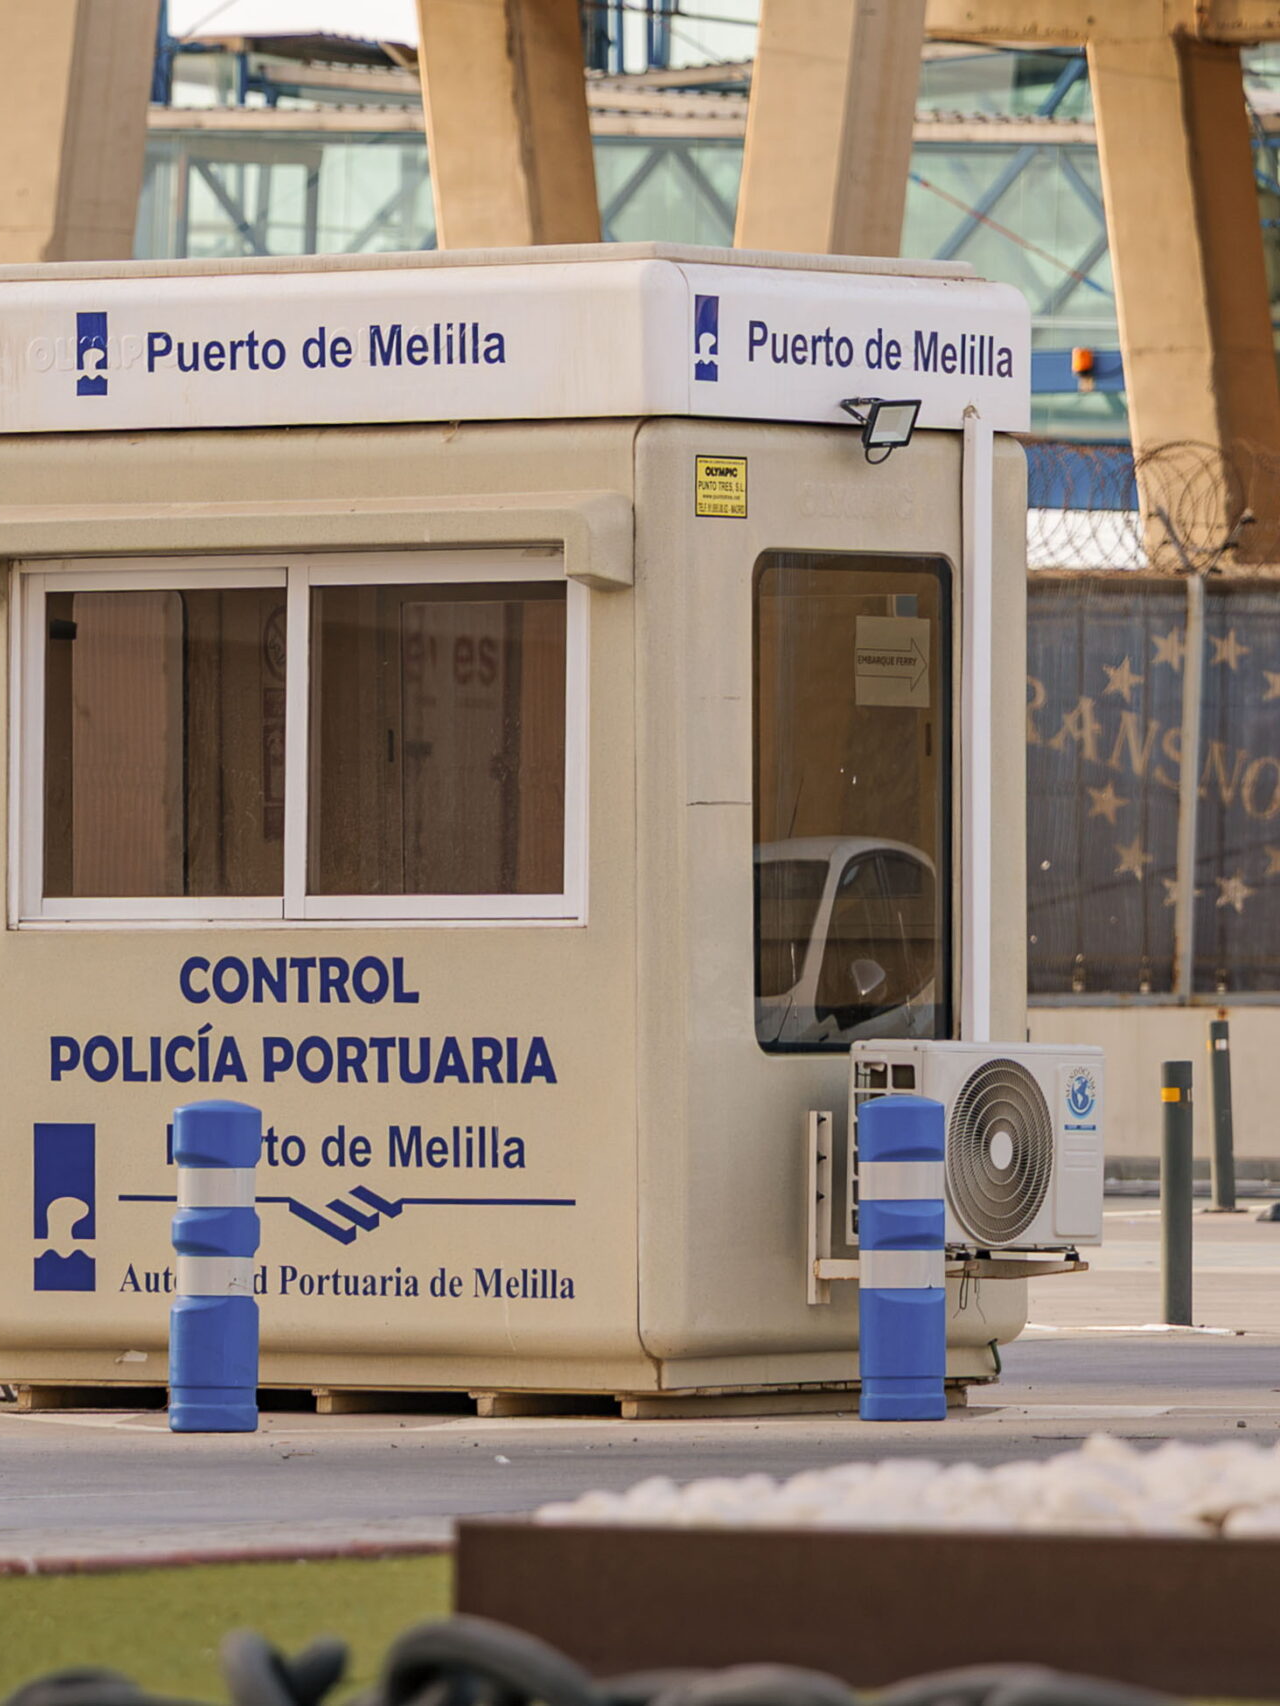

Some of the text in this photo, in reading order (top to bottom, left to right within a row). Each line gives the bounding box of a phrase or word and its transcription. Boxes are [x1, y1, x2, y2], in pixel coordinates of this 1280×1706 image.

[147, 330, 286, 373] Puerto
[302, 326, 353, 369] de
[369, 322, 506, 367] Melilla
[748, 320, 1013, 378] Puerto de Melilla
[705, 466, 738, 478] OLYMPIC
[179, 955, 420, 1004] CONTROL
[50, 1022, 558, 1084] POLICÍA PORTUARIA
[321, 1125, 372, 1167] de
[388, 1125, 526, 1168] Melilla
[279, 1265, 418, 1297] Portuaria
[430, 1268, 463, 1297] de
[474, 1268, 575, 1299] Melilla
